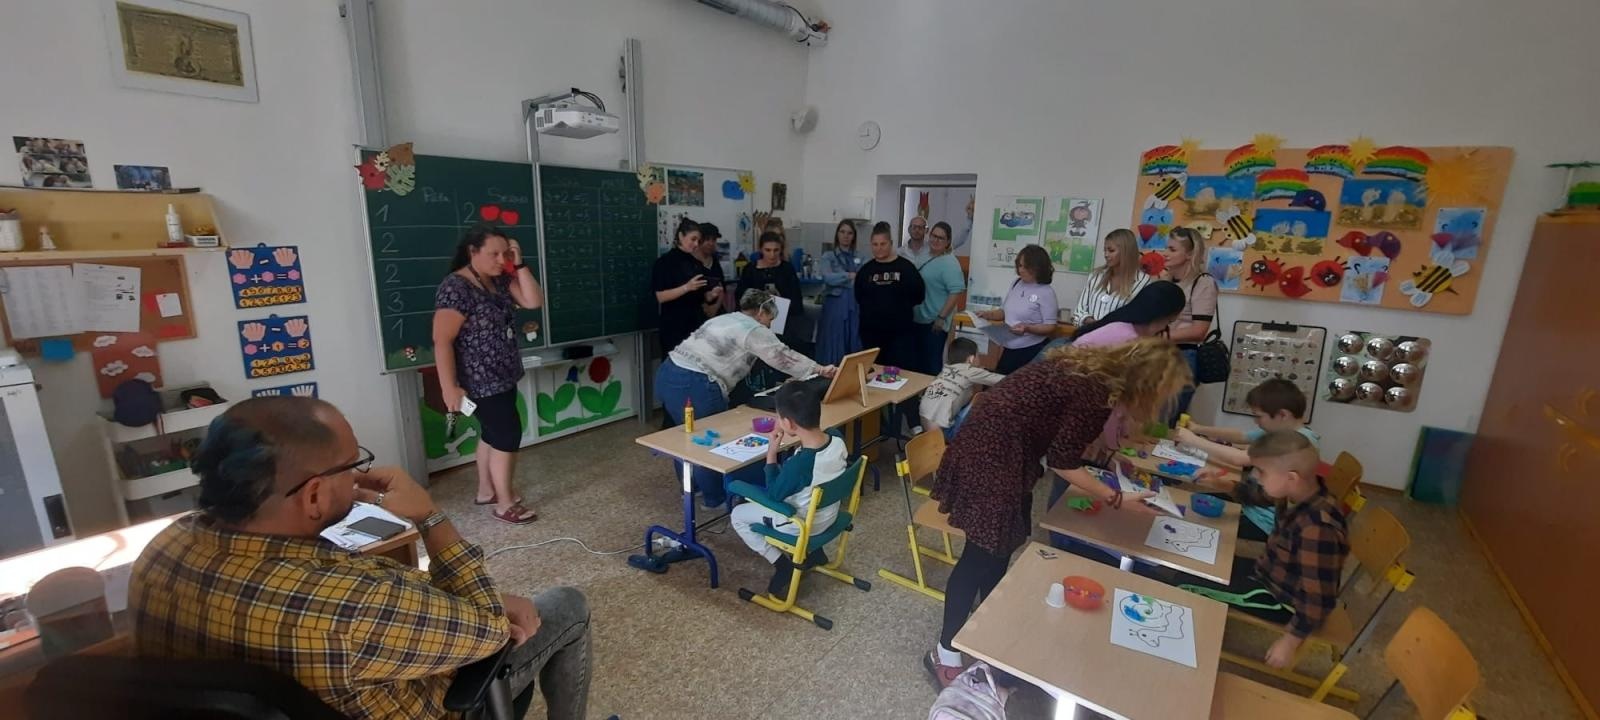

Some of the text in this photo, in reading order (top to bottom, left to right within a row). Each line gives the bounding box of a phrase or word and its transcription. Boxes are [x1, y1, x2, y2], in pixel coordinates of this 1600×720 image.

[375, 204, 389, 222] 1
[463, 202, 479, 223] 2
[381, 232, 400, 253] 2
[385, 263, 401, 284] 2
[387, 291, 404, 313] 3
[391, 318, 403, 339] 1
